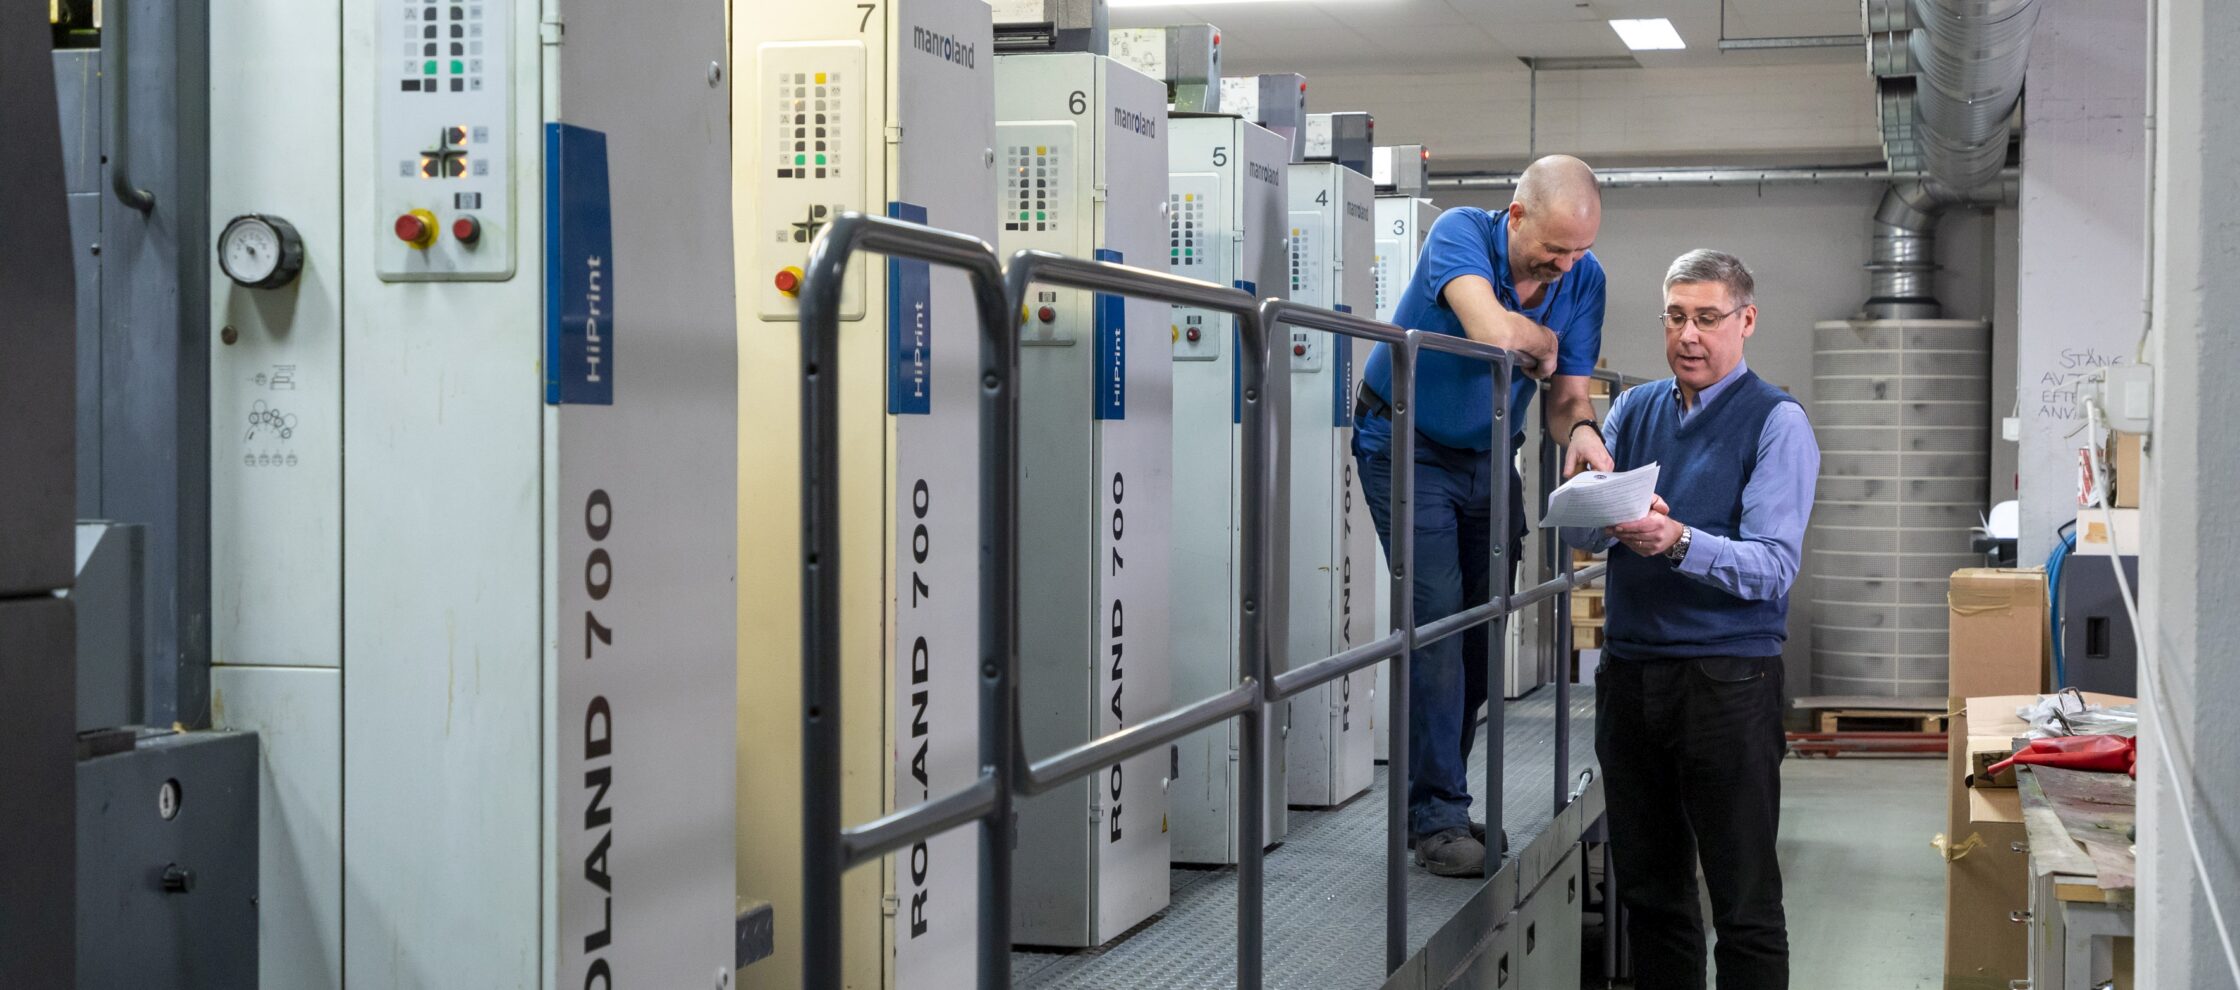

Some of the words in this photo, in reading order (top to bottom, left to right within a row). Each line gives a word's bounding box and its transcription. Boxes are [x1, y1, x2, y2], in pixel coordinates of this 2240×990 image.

[857, 3, 876, 33] 7
[913, 24, 975, 70] manroland
[1068, 90, 1087, 116] 6
[1114, 106, 1155, 140] manroland
[1212, 146, 1227, 168] 5
[1249, 161, 1279, 187] manroland
[1315, 189, 1329, 207] 4
[1393, 219, 1405, 236] 3
[587, 255, 602, 382] HiPrint
[914, 301, 924, 397] HiPrint
[2041, 371, 2065, 386] AV
[2038, 405, 2078, 420] ANV
[912, 478, 930, 609] 700
[1112, 471, 1124, 577] 700
[585, 488, 613, 660] 700
[1342, 555, 1351, 732] ROAND
[1110, 598, 1124, 844] ROAND
[911, 635, 929, 940] ROAND
